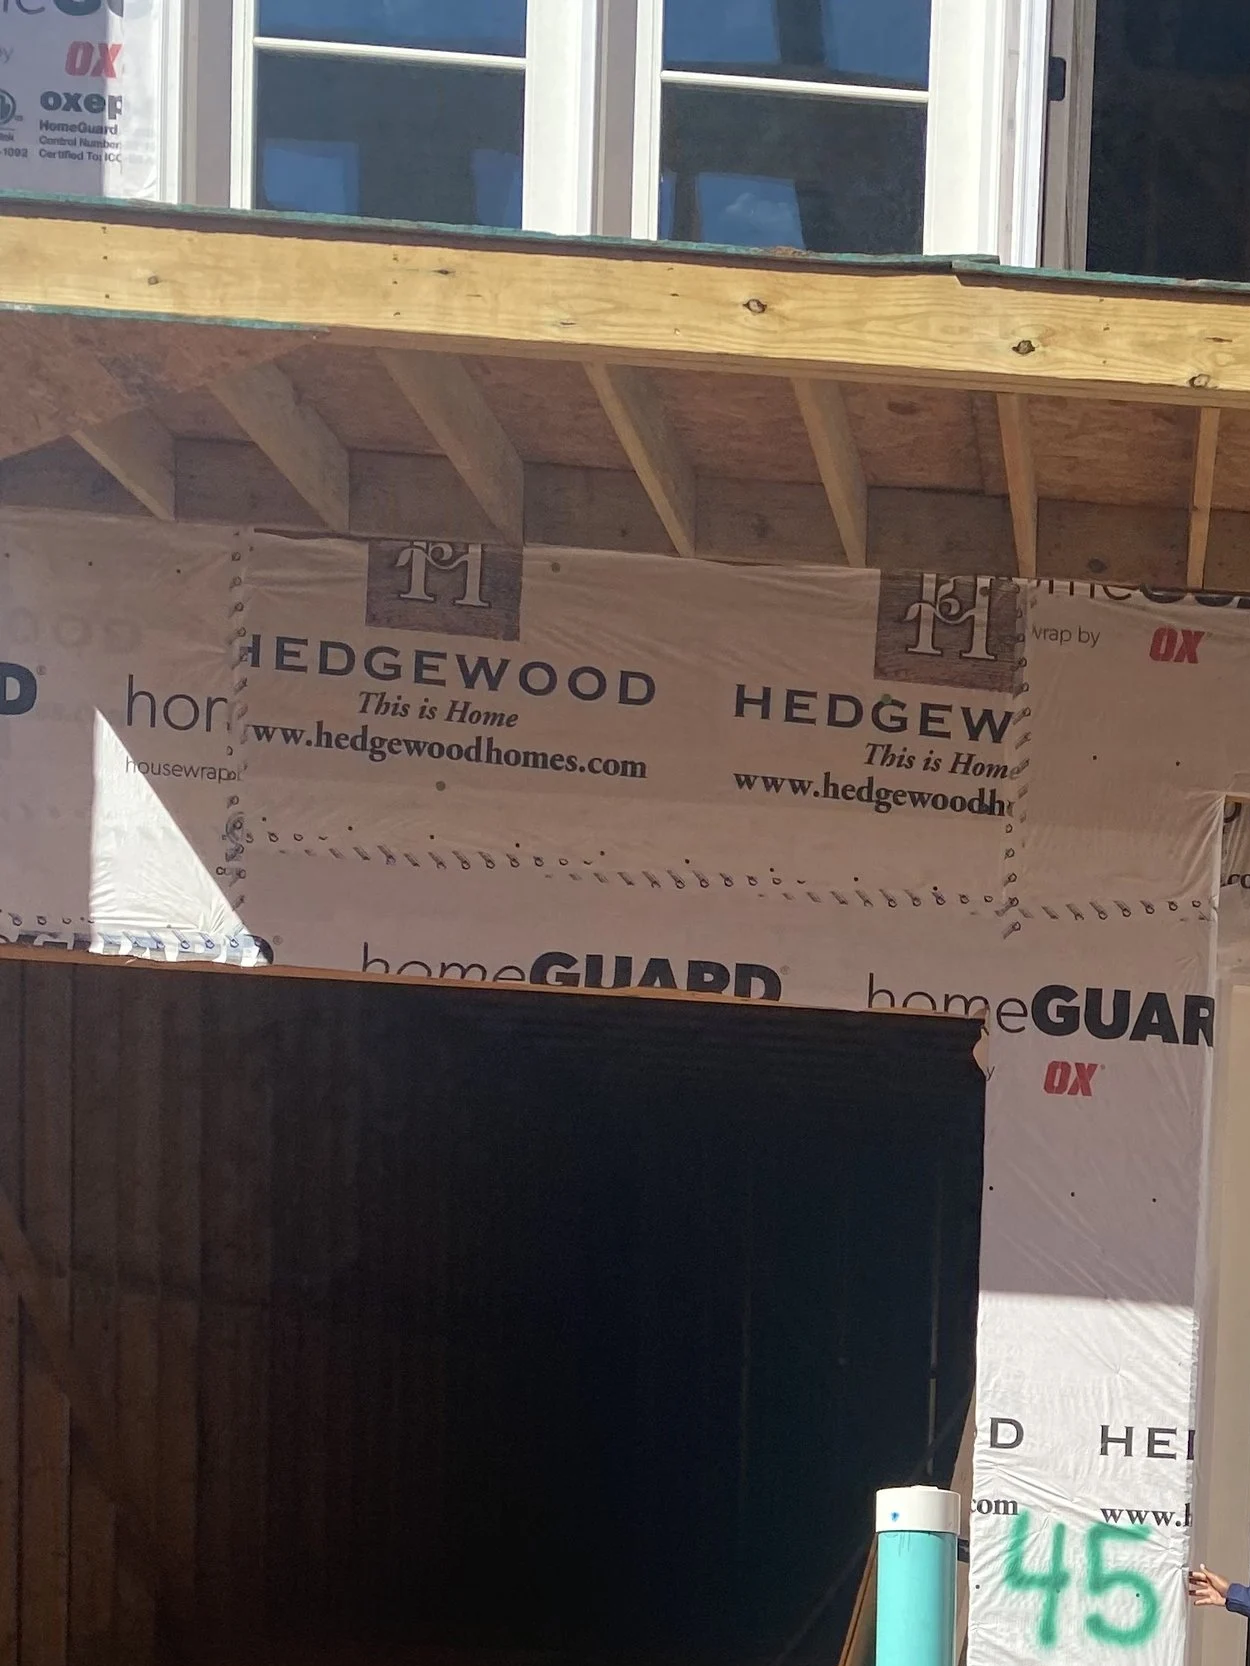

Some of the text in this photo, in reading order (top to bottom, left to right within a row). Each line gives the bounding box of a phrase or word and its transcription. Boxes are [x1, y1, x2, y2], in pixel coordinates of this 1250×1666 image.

[65, 41, 122, 78] OX
[39, 119, 118, 135] HomeGuard
[1078, 626, 1100, 648] by
[1150, 626, 1204, 664] OX
[358, 691, 519, 728] This is Home
[864, 742, 942, 773] This is
[1043, 1061, 1098, 1097] OX
[1003, 1508, 1159, 1647] 45
